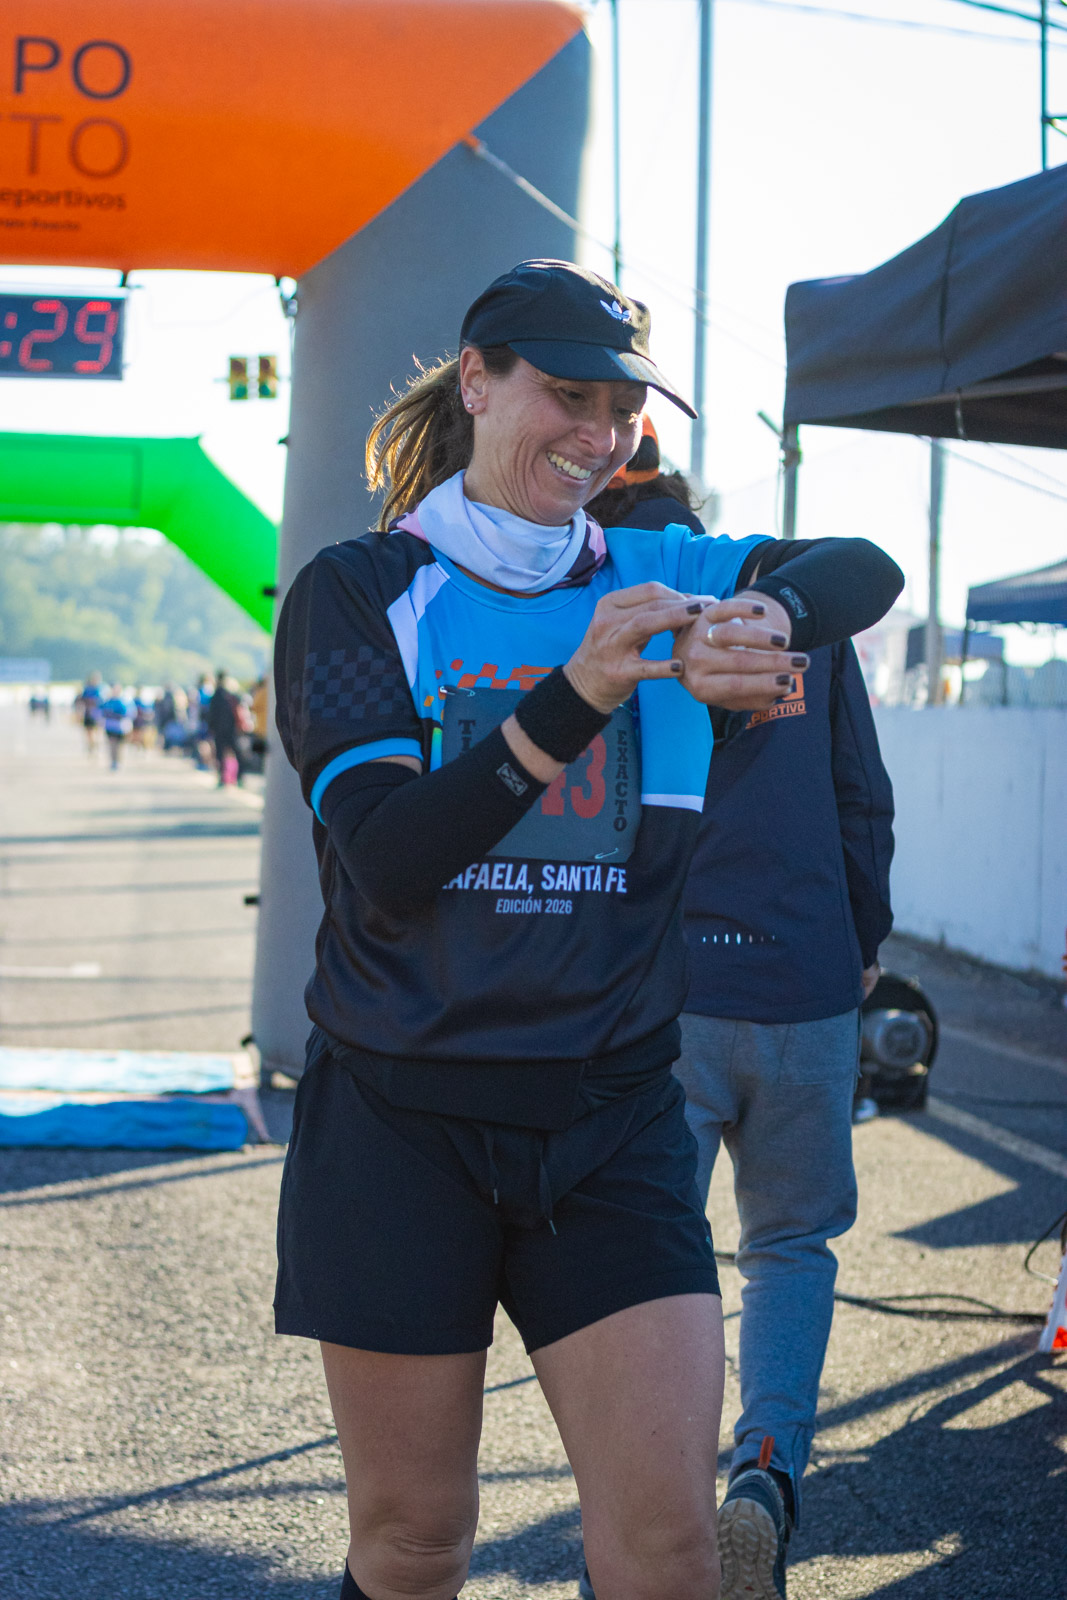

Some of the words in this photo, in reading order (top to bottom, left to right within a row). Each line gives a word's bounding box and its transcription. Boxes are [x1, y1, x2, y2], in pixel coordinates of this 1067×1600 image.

[14, 36, 133, 101] PO
[0, 112, 130, 180] TO
[746, 701, 806, 728] PORTIVO
[613, 729, 629, 832] EXACTO
[442, 863, 535, 894] AFAELA,
[541, 864, 602, 892] SANTA
[605, 866, 627, 893] FE
[495, 896, 542, 914] EDICIÓN
[544, 898, 573, 914] 2026
